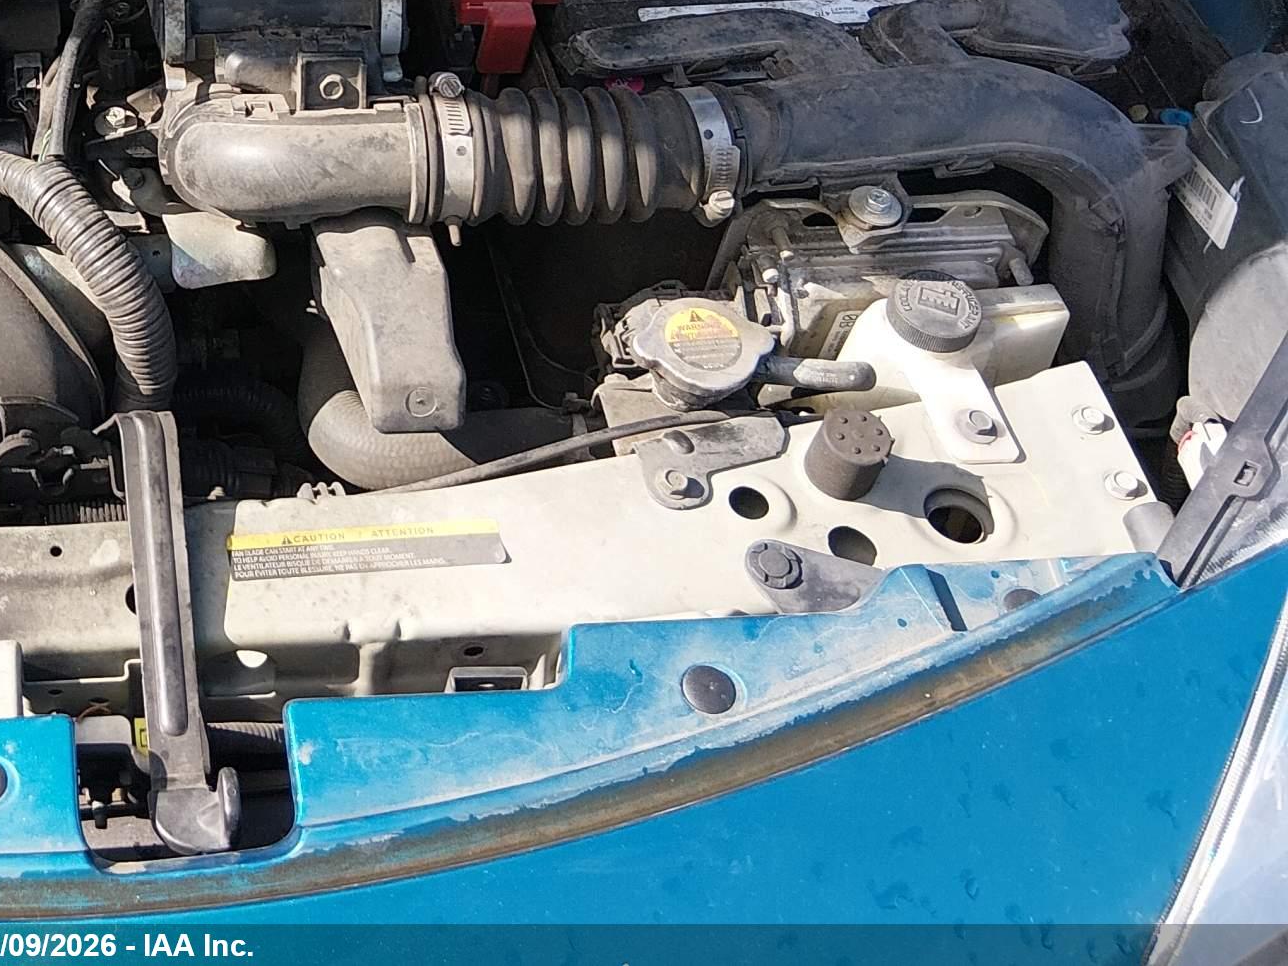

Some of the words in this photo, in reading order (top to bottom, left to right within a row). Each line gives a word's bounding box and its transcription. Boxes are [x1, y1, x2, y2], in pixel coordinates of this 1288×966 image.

[293, 532, 345, 542] CAUTION
[370, 526, 434, 537] ATTENTION
[278, 552, 309, 560] PERSONAL
[242, 561, 285, 569] VENTILATEUR
[234, 570, 254, 578] POUR
[277, 567, 299, 575] TOUTE
